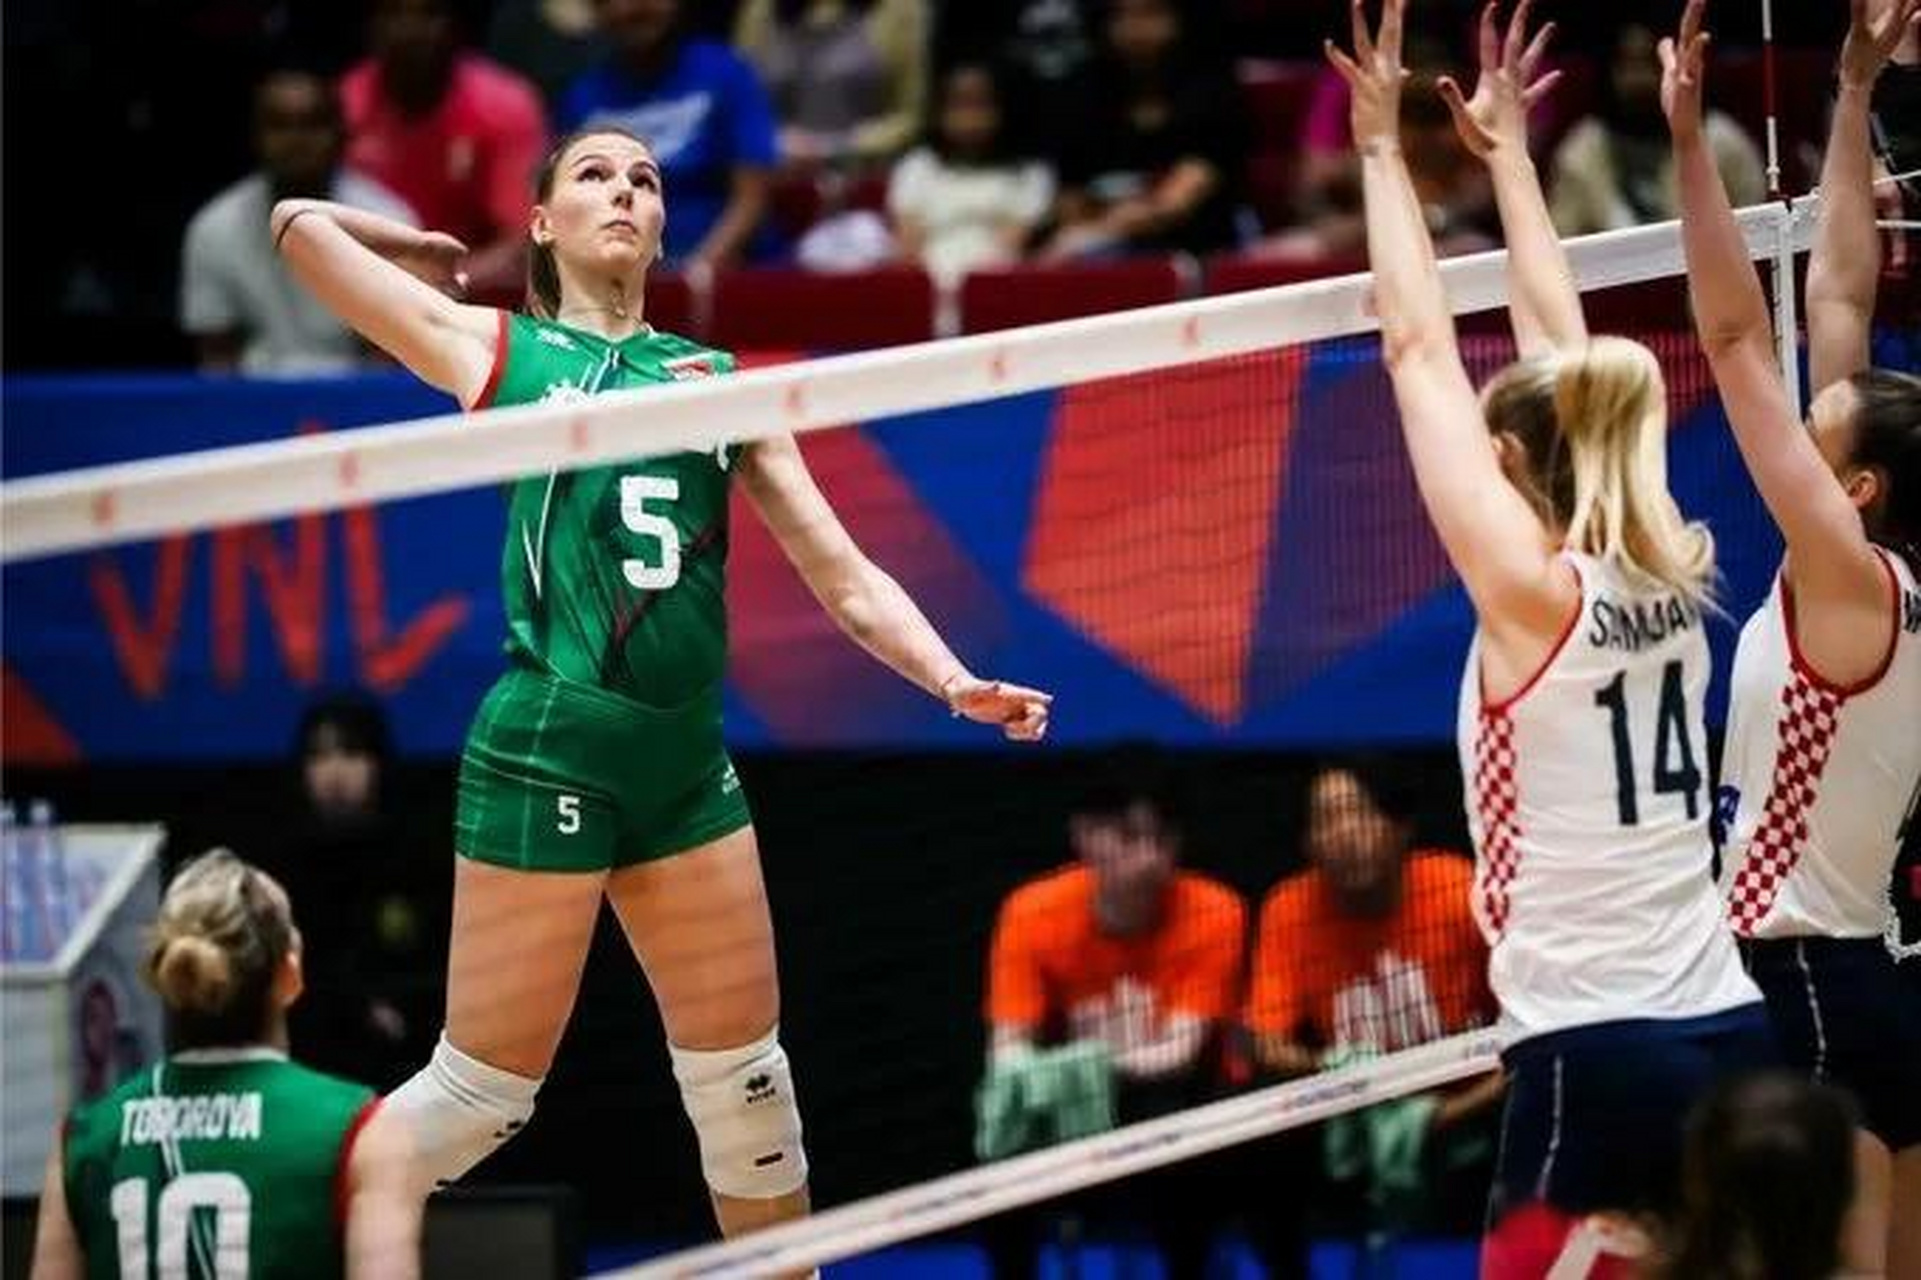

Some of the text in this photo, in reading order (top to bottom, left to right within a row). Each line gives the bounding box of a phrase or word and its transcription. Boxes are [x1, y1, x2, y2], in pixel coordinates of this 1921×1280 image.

[88, 422, 468, 702] VNL
[620, 475, 682, 589] 5
[1595, 659, 1701, 826] 14
[558, 795, 580, 834] 5
[110, 1172, 252, 1280] 10
